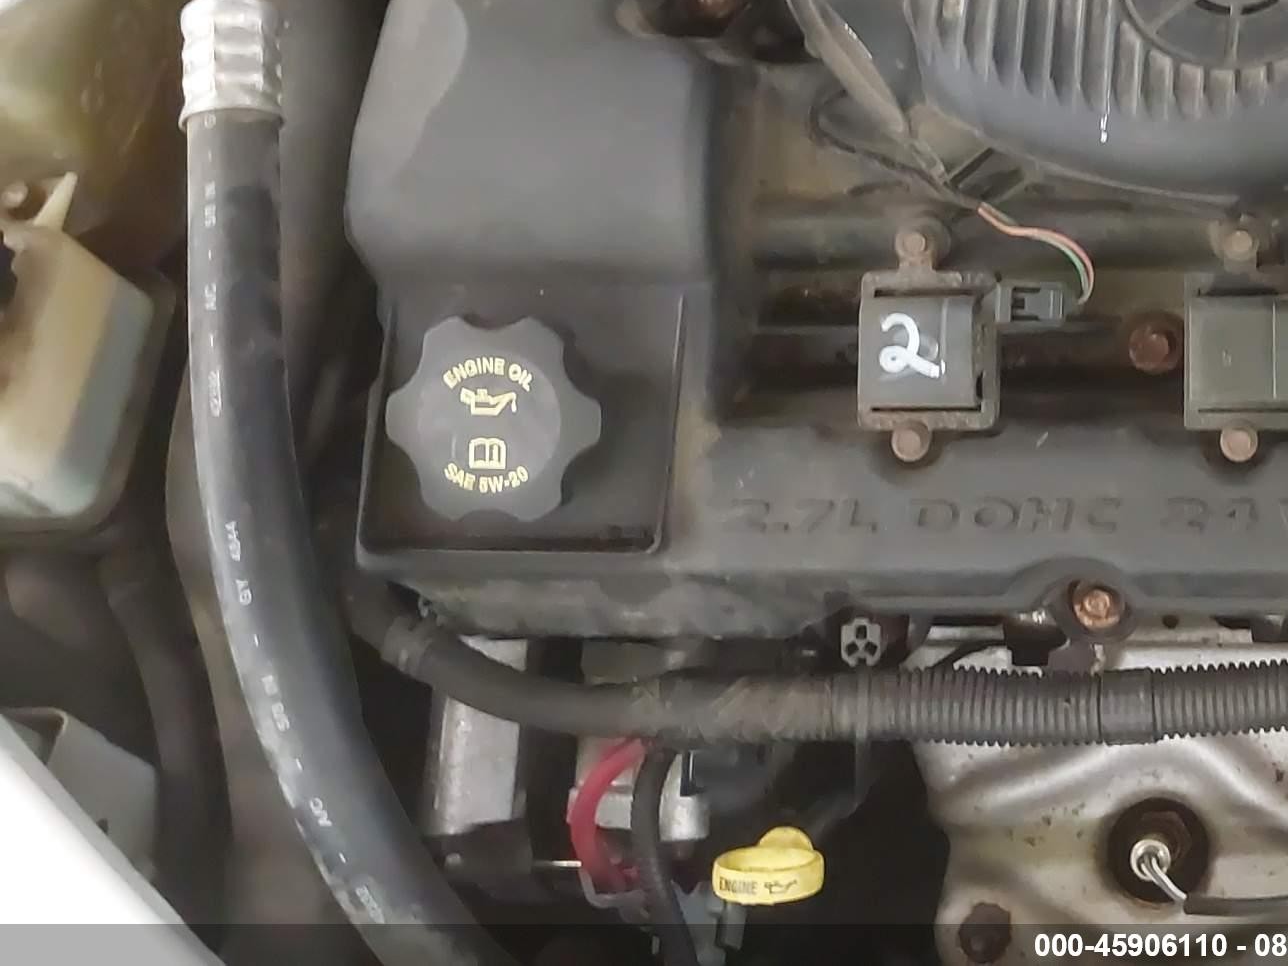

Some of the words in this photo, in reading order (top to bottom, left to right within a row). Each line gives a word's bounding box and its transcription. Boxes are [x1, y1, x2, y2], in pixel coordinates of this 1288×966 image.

[879, 312, 940, 379] 2
[443, 357, 505, 389] ENGINE
[508, 363, 533, 392] OIL
[444, 462, 476, 491] SAE
[478, 465, 529, 493] 5W-20
[732, 497, 879, 533] 2.7L
[908, 497, 1122, 533] DOHC
[719, 877, 757, 894] ENGINE
